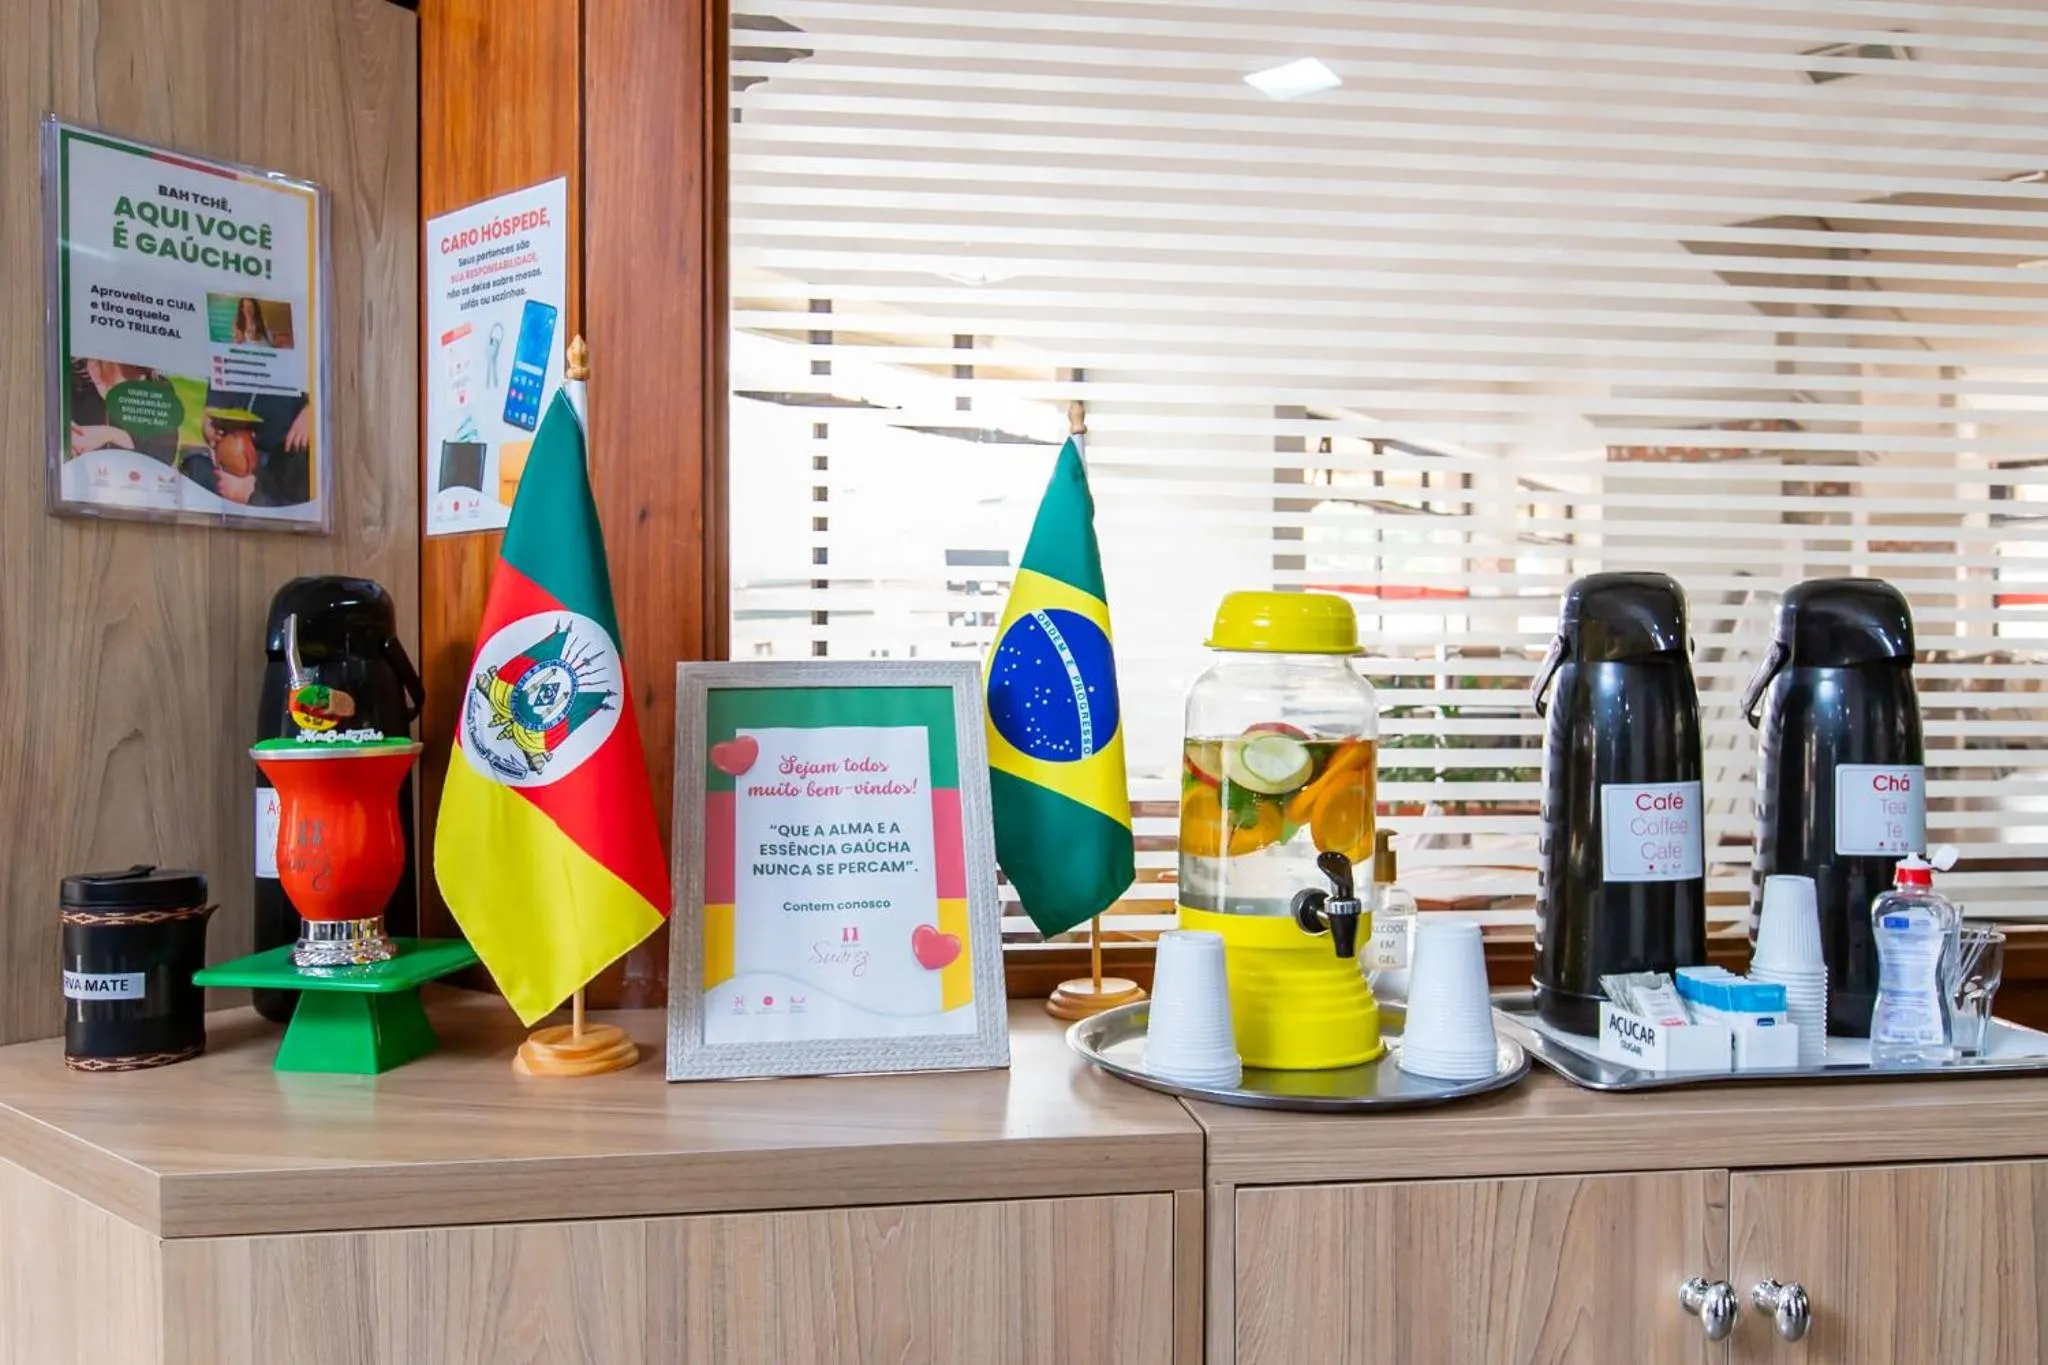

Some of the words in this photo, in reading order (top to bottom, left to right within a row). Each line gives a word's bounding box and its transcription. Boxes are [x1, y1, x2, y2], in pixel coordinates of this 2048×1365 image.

[158, 185, 189, 202] BAH
[192, 192, 232, 214] TCHÊ,
[114, 196, 189, 232] AQUI
[196, 213, 272, 250] VOCÊ
[441, 229, 478, 255] CARO
[481, 207, 550, 243] HÓSPEDE,
[113, 221, 129, 249] É
[135, 232, 272, 280] GAÚCHO!
[458, 256, 476, 268] Seus
[476, 244, 514, 265] pertences
[516, 240, 530, 252] são
[446, 288, 460, 300] não
[462, 286, 470, 296] os
[471, 280, 491, 294] deixe
[492, 274, 514, 289] sobre
[90, 302, 98, 310] e
[101, 302, 124, 315] tira
[126, 307, 170, 324] aquela
[156, 297, 164, 306] a
[167, 300, 196, 313] CUIA
[460, 298, 478, 311] sofás
[480, 296, 490, 305] ou
[90, 315, 124, 330] FOTO
[128, 321, 182, 340] TRILEGAL
[1037, 613, 1067, 652] ORDEM
[1072, 675, 1092, 754] PROGRESSO
[778, 755, 840, 780] Sejam
[843, 756, 890, 772] todos
[748, 782, 802, 798] muito
[1873, 772, 1910, 792] Chá
[1878, 798, 1907, 816] Tea
[814, 824, 826, 837] A
[829, 822, 873, 836] ALMA
[878, 822, 886, 834] E
[890, 822, 901, 834] A
[1630, 816, 1688, 837] Coffee
[760, 838, 837, 857] ESSÊNCIA
[841, 837, 910, 855] GAÚCHA
[752, 862, 812, 877] NUNCA
[816, 862, 834, 876] SE
[782, 900, 834, 912] Contem
[837, 900, 892, 911] conosco
[1380, 940, 1395, 949] EM
[1379, 955, 1396, 964] GEL
[84, 979, 129, 992] MATE
